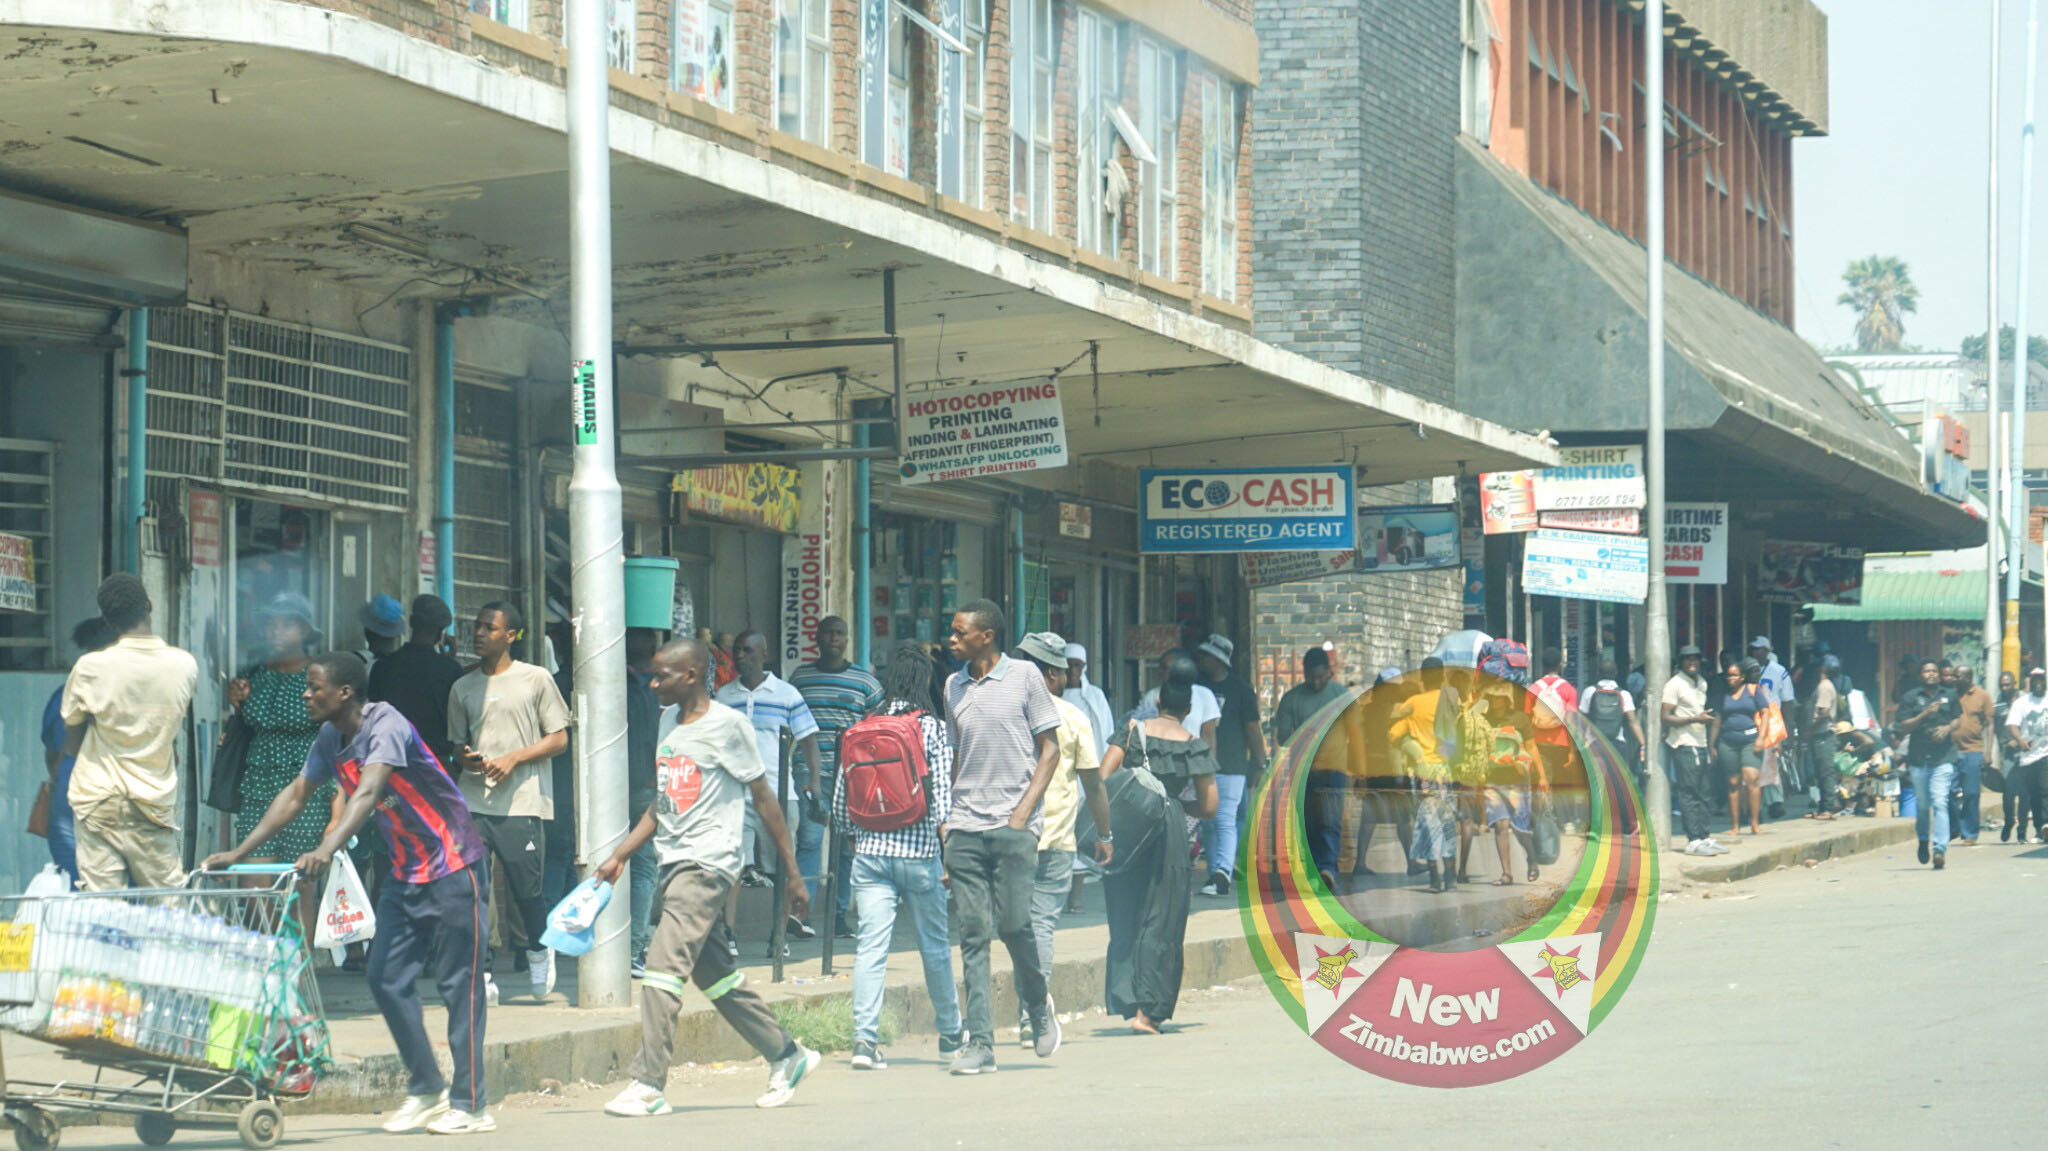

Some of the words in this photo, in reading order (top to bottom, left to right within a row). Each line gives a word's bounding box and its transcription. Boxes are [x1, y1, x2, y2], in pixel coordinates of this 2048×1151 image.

[583, 372, 597, 434] MAIDS
[907, 384, 1057, 417] HOTOCOPYING
[907, 431, 957, 448] INDING
[960, 428, 972, 441] &
[975, 416, 1059, 438] LAMINATING
[928, 406, 1013, 430] PRINTING
[904, 444, 965, 462] AFFIDAVIT
[966, 432, 1055, 455] (FINGERPRINT)
[918, 453, 985, 472] WHATSAPP
[989, 444, 1062, 463] UNLOCKING
[1560, 448, 1628, 465] -SHIRT
[928, 473, 936, 482] T
[939, 466, 976, 481] SHIRT
[978, 459, 1037, 475] PRINTING
[1541, 463, 1636, 482] PRINTING
[1242, 478, 1334, 507] CASH
[1156, 523, 1273, 540] REGISTERED
[1279, 521, 1345, 538] AGENT
[1664, 509, 1723, 525] IRTIME
[786, 567, 799, 660] PRINTING
